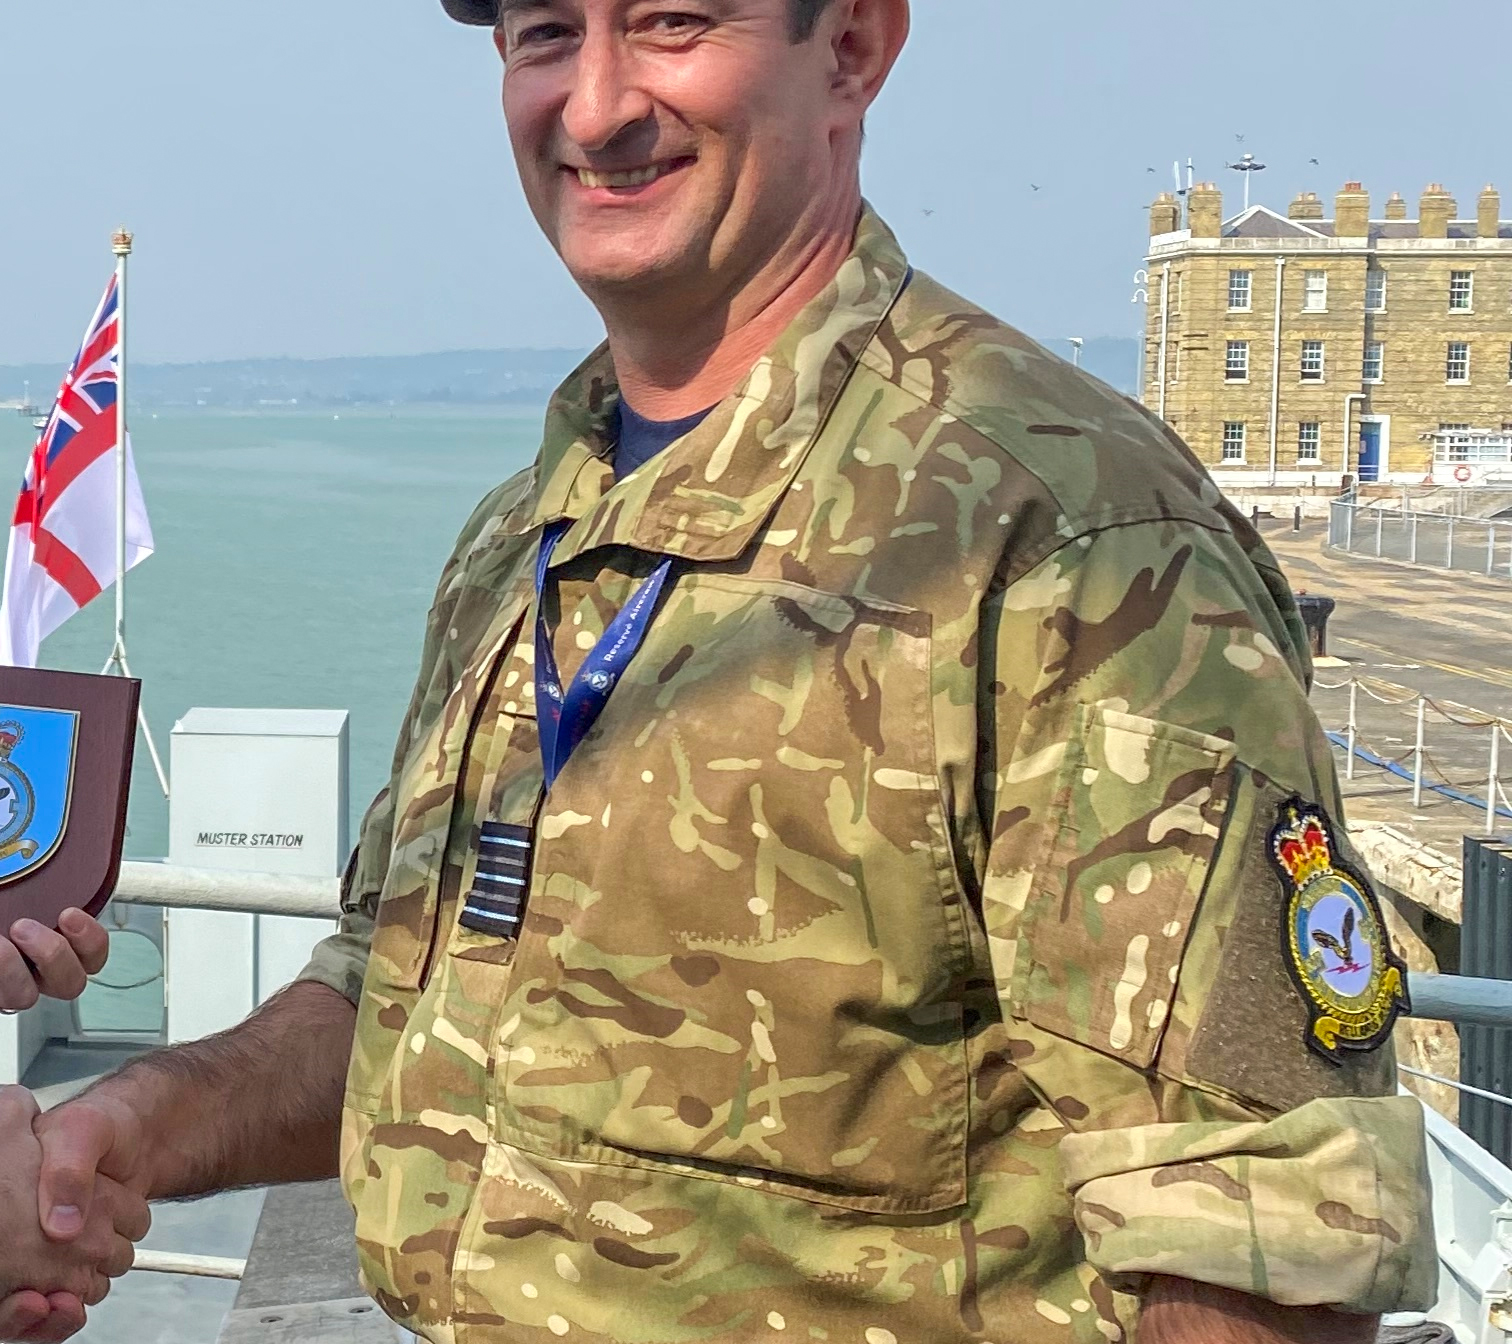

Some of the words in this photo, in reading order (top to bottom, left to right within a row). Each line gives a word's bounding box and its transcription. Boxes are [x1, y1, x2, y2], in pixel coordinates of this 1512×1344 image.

[603, 623, 633, 662] Reserve
[197, 833, 247, 845] MUSTER
[250, 834, 303, 847] STATION
